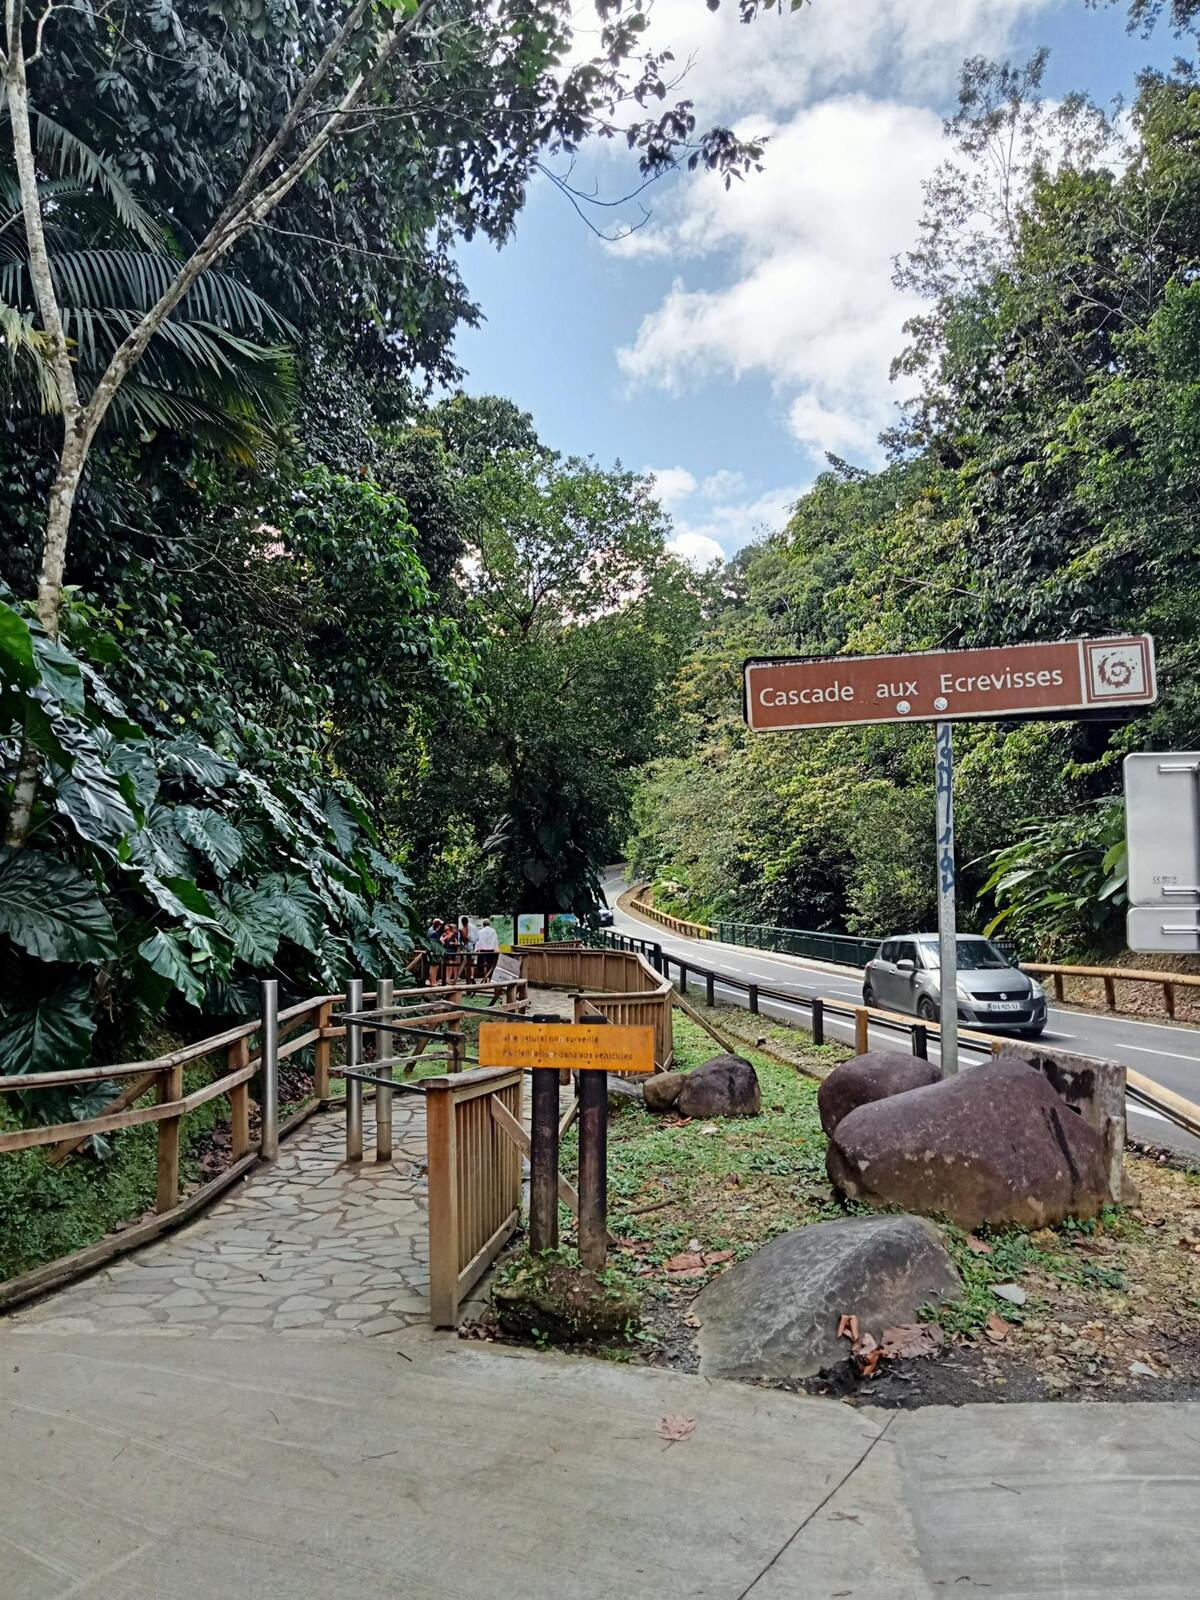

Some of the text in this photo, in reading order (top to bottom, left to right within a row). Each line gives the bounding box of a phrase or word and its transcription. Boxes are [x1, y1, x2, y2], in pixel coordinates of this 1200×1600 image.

[759, 667, 1064, 707] Cascade aux Ecrevisses
